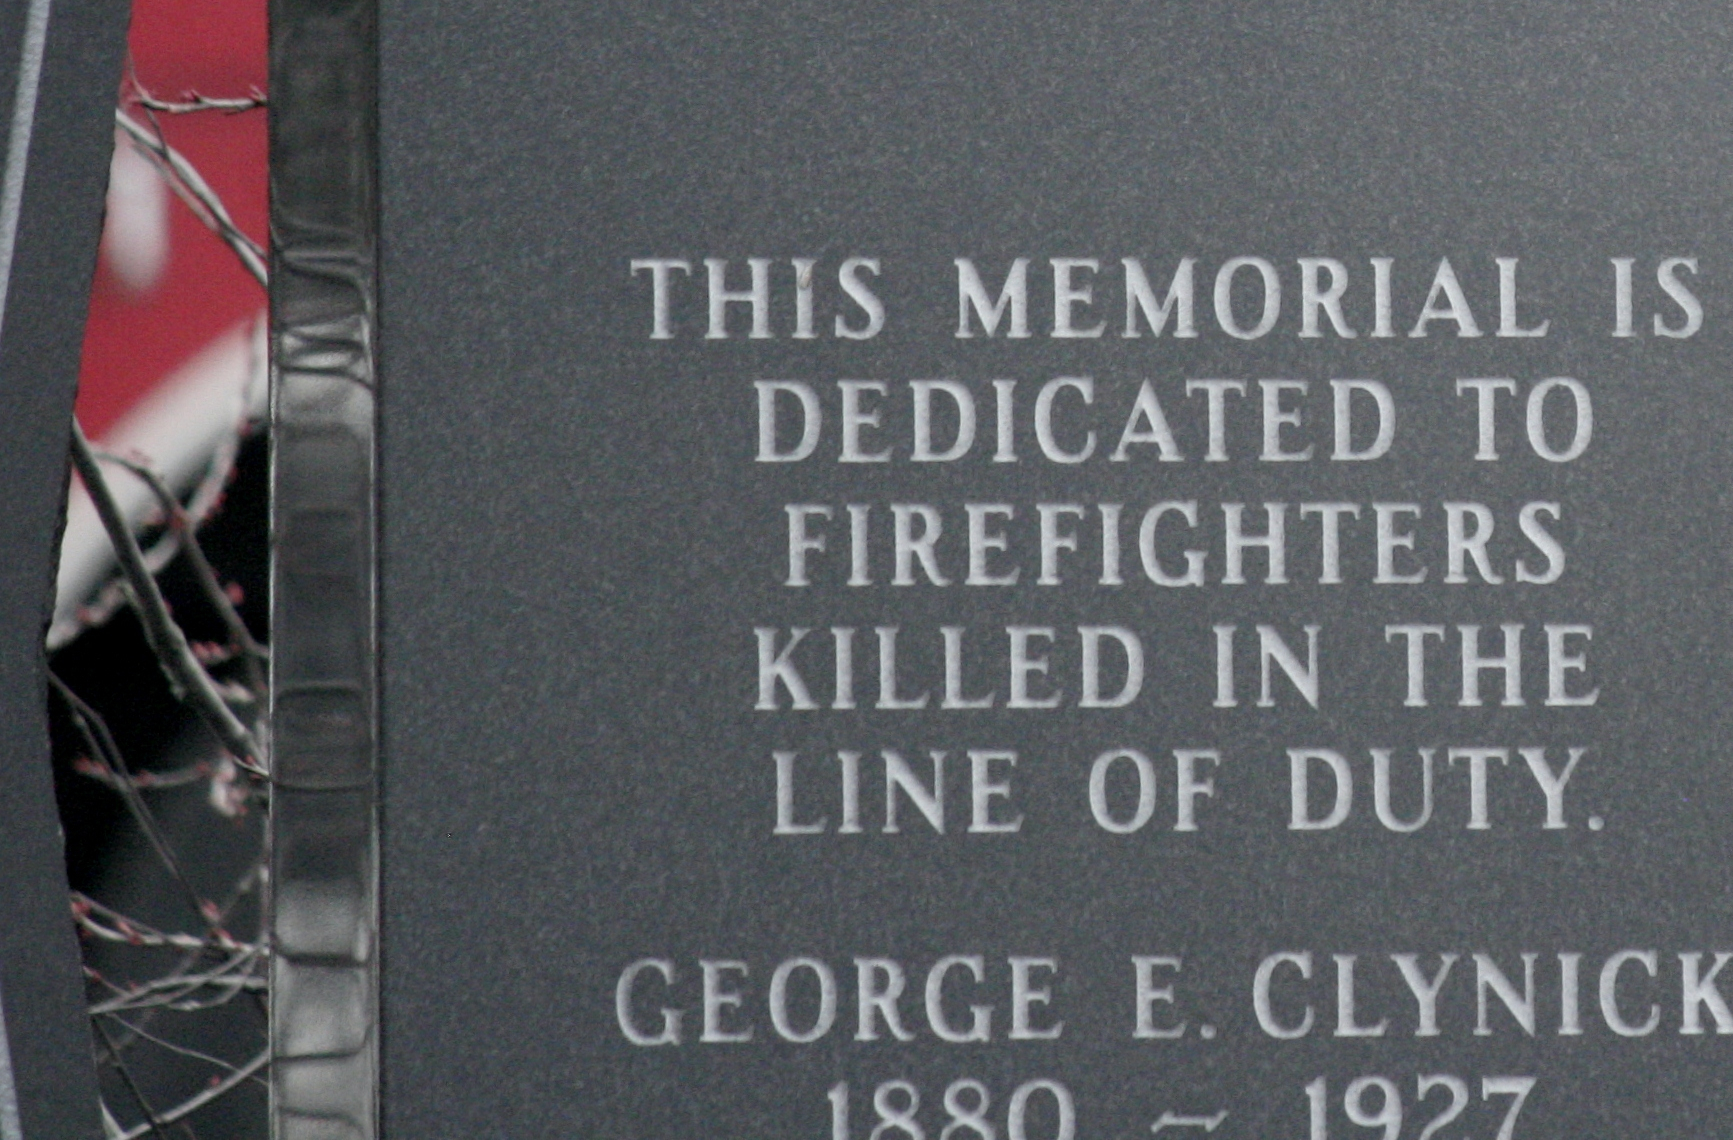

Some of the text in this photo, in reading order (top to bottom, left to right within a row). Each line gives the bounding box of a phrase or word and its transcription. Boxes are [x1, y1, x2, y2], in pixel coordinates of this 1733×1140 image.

[630, 255, 1705, 342] THIS MEMORIAL IS
[753, 375, 1594, 465] DEDICATED TO
[784, 499, 1566, 588] FIREFIGHTERS
[753, 622, 1601, 711] KILLED IN THE
[772, 746, 1606, 835] LINE OF DUTY.
[614, 955, 1064, 1046] GEORGE
[1131, 955, 1217, 1039] E.
[826, 1078, 1076, 1140] 1880
[1304, 1074, 1537, 1140] 1927
